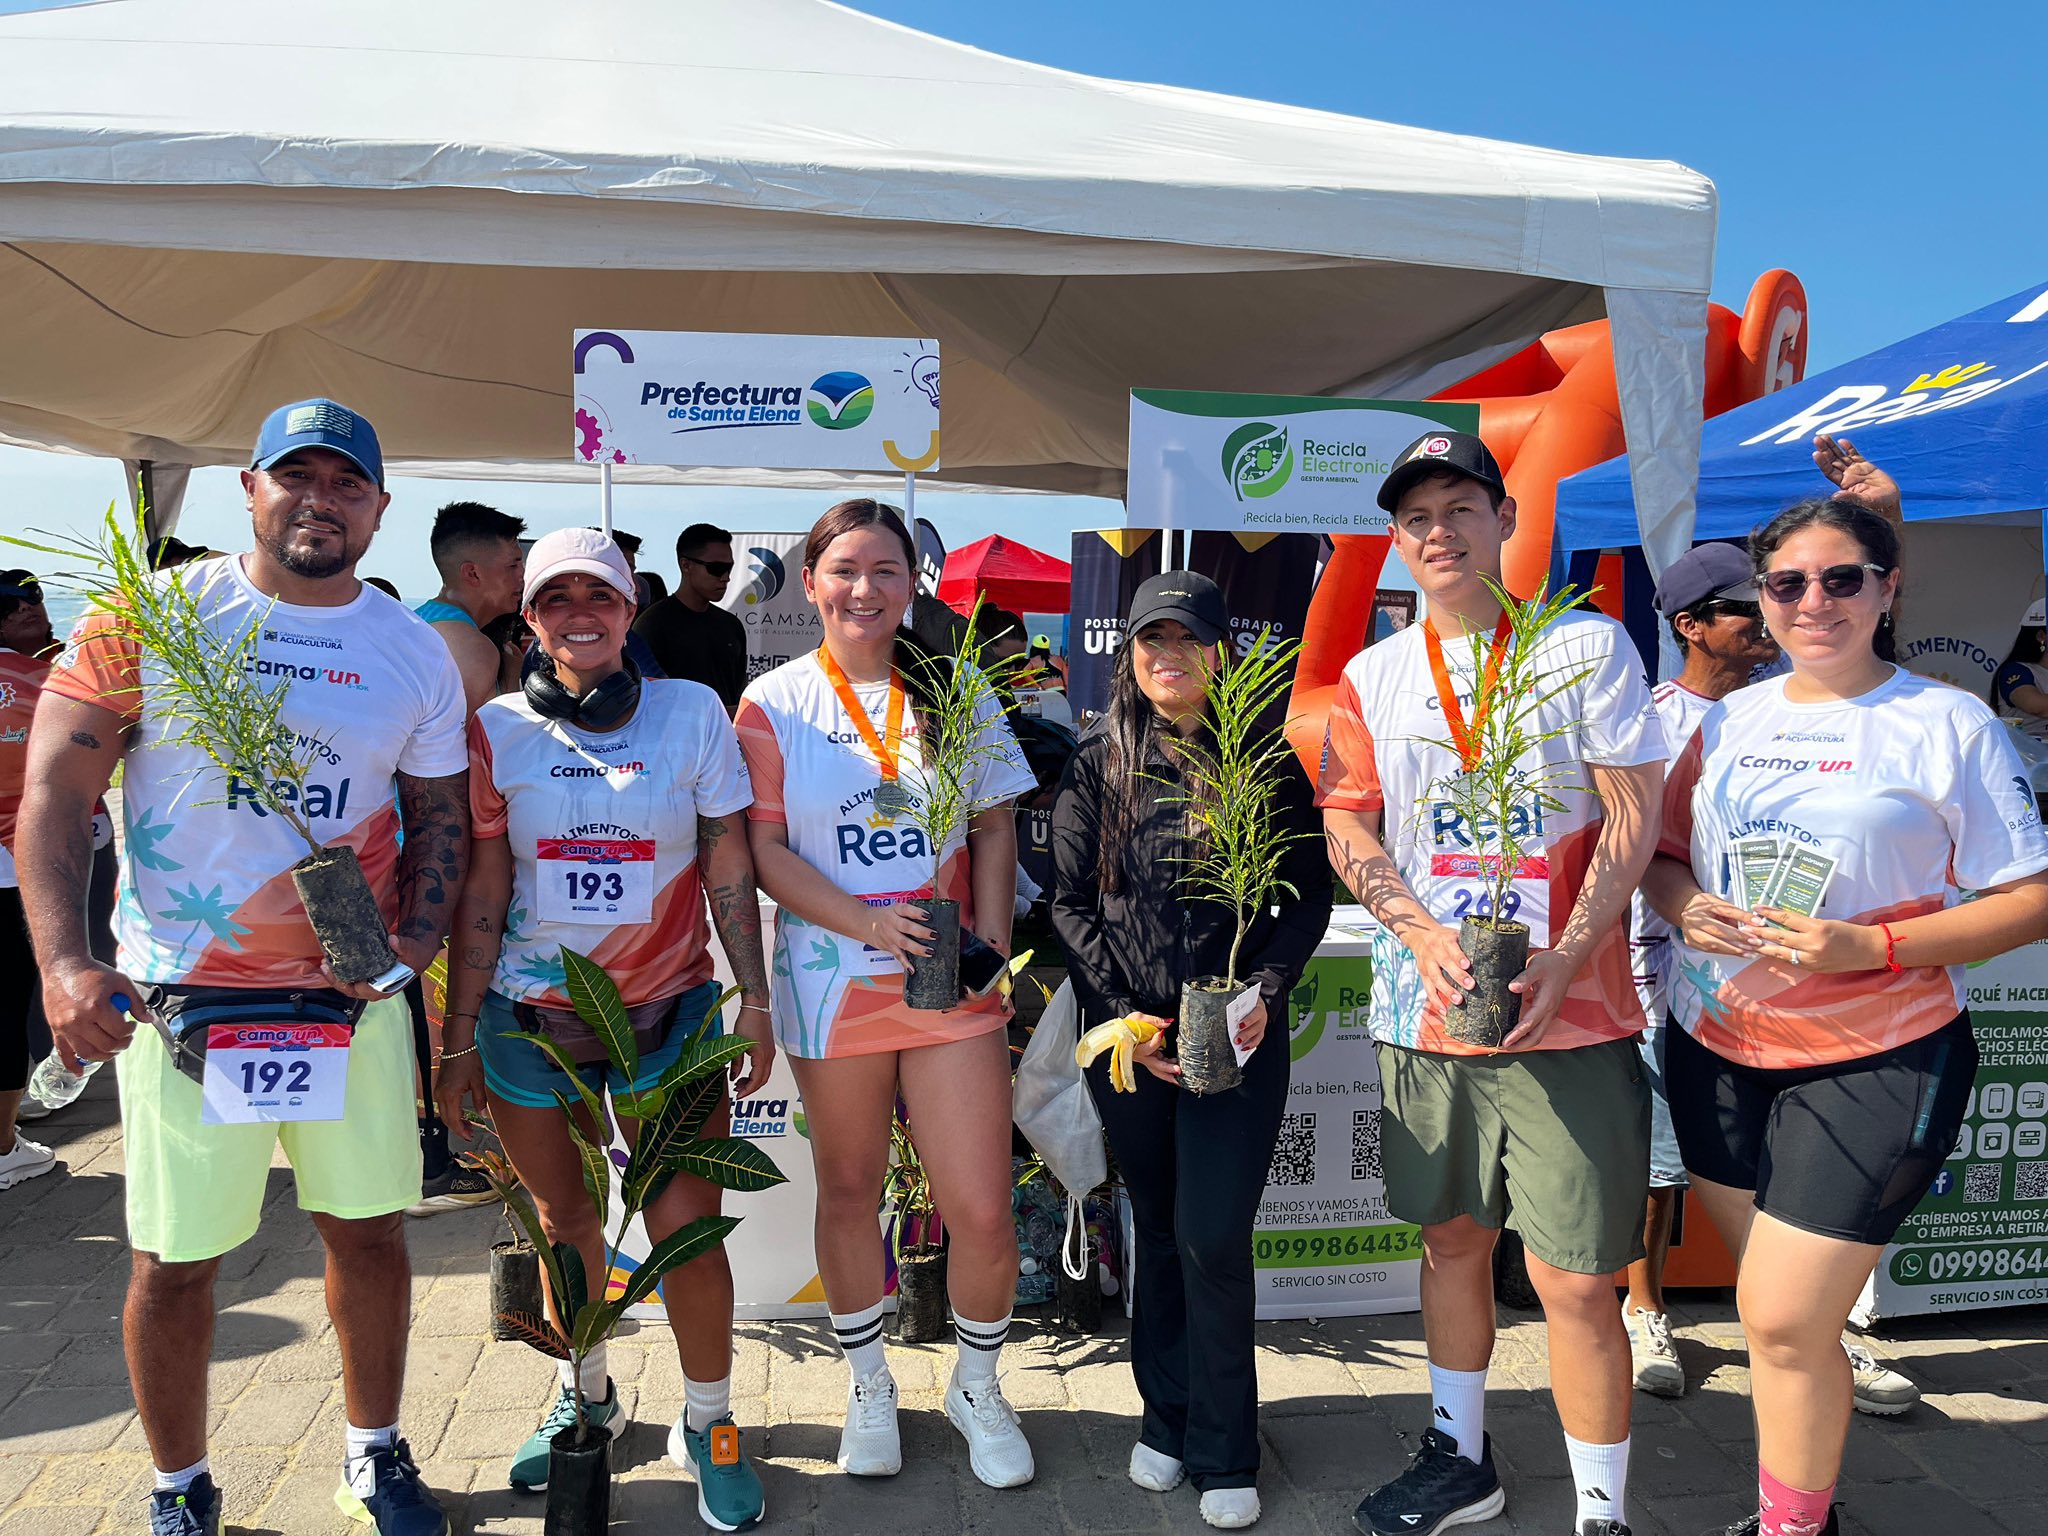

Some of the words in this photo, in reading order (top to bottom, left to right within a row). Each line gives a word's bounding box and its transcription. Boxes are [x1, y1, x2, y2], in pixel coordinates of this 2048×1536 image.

[641, 381, 802, 405] Prefectura
[667, 407, 687, 419] de
[688, 406, 746, 421] Santa
[748, 406, 801, 421] Elena
[1303, 440, 1367, 457] Recicla
[1302, 456, 1389, 474] Electronic
[1243, 512, 1282, 524] ¡Recicla
[1284, 513, 1310, 525] bien,
[1312, 514, 1349, 525] Recicla
[279, 636, 344, 651] ACUACULTURA
[1230, 631, 1281, 662] SE
[566, 871, 624, 900] 193
[1453, 887, 1522, 920] 269
[241, 1060, 313, 1094] 192
[1288, 1082, 1312, 1095] icla
[1316, 1081, 1350, 1095] bien,
[731, 1119, 787, 1134] Elena
[1307, 1200, 1318, 1211] Y
[1317, 1198, 1359, 1211] VAMOS
[1361, 1198, 1370, 1208] A
[1265, 1213, 1319, 1225] EMPRESA
[1322, 1212, 1331, 1223] A
[1900, 1211, 1978, 1227] SCRÍBENOS
[1980, 1211, 1990, 1222] Y
[1991, 1208, 2041, 1222] VAMOS
[1917, 1227, 1928, 1239] O
[1930, 1224, 1993, 1239] EMPRESA
[1994, 1223, 2006, 1235] A
[1256, 1230, 1424, 1260] 0999864434
[1271, 1276, 1325, 1288] SERVICIO
[1327, 1274, 1346, 1287] SIN
[1349, 1271, 1388, 1284] COSTO
[1929, 1291, 1991, 1306] SERVICIO
[1992, 1289, 2015, 1302] SIN
